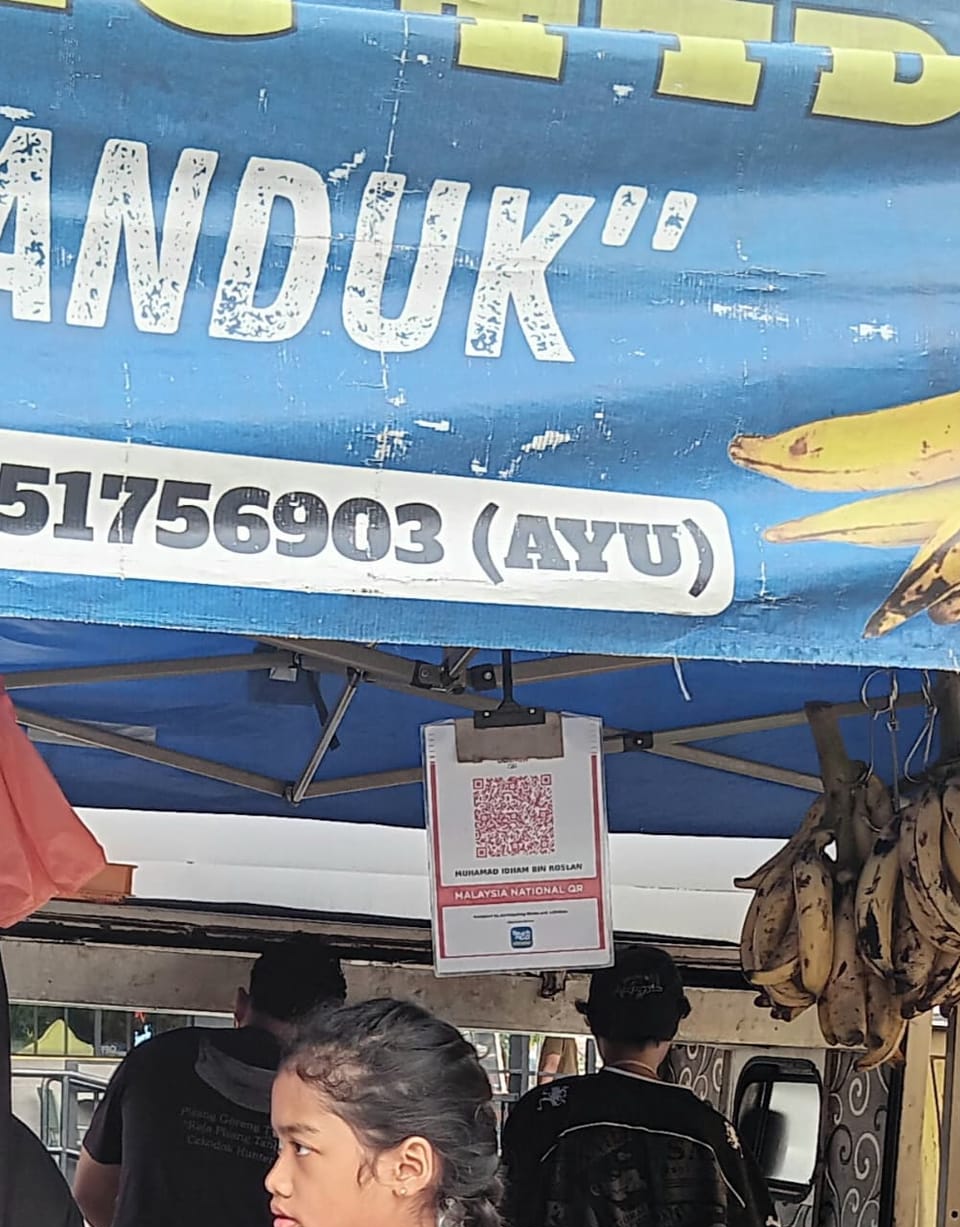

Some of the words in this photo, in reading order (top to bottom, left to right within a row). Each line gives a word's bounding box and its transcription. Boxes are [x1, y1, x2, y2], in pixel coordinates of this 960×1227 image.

[0, 462, 446, 563] 51756903
[472, 501, 714, 598] (AYU)
[532, 865, 546, 873] BIN
[549, 863, 583, 872] ROSLAN
[455, 890, 508, 900] MALAYSIA
[510, 886, 565, 897] NATIONAL
[567, 884, 583, 893] QR
